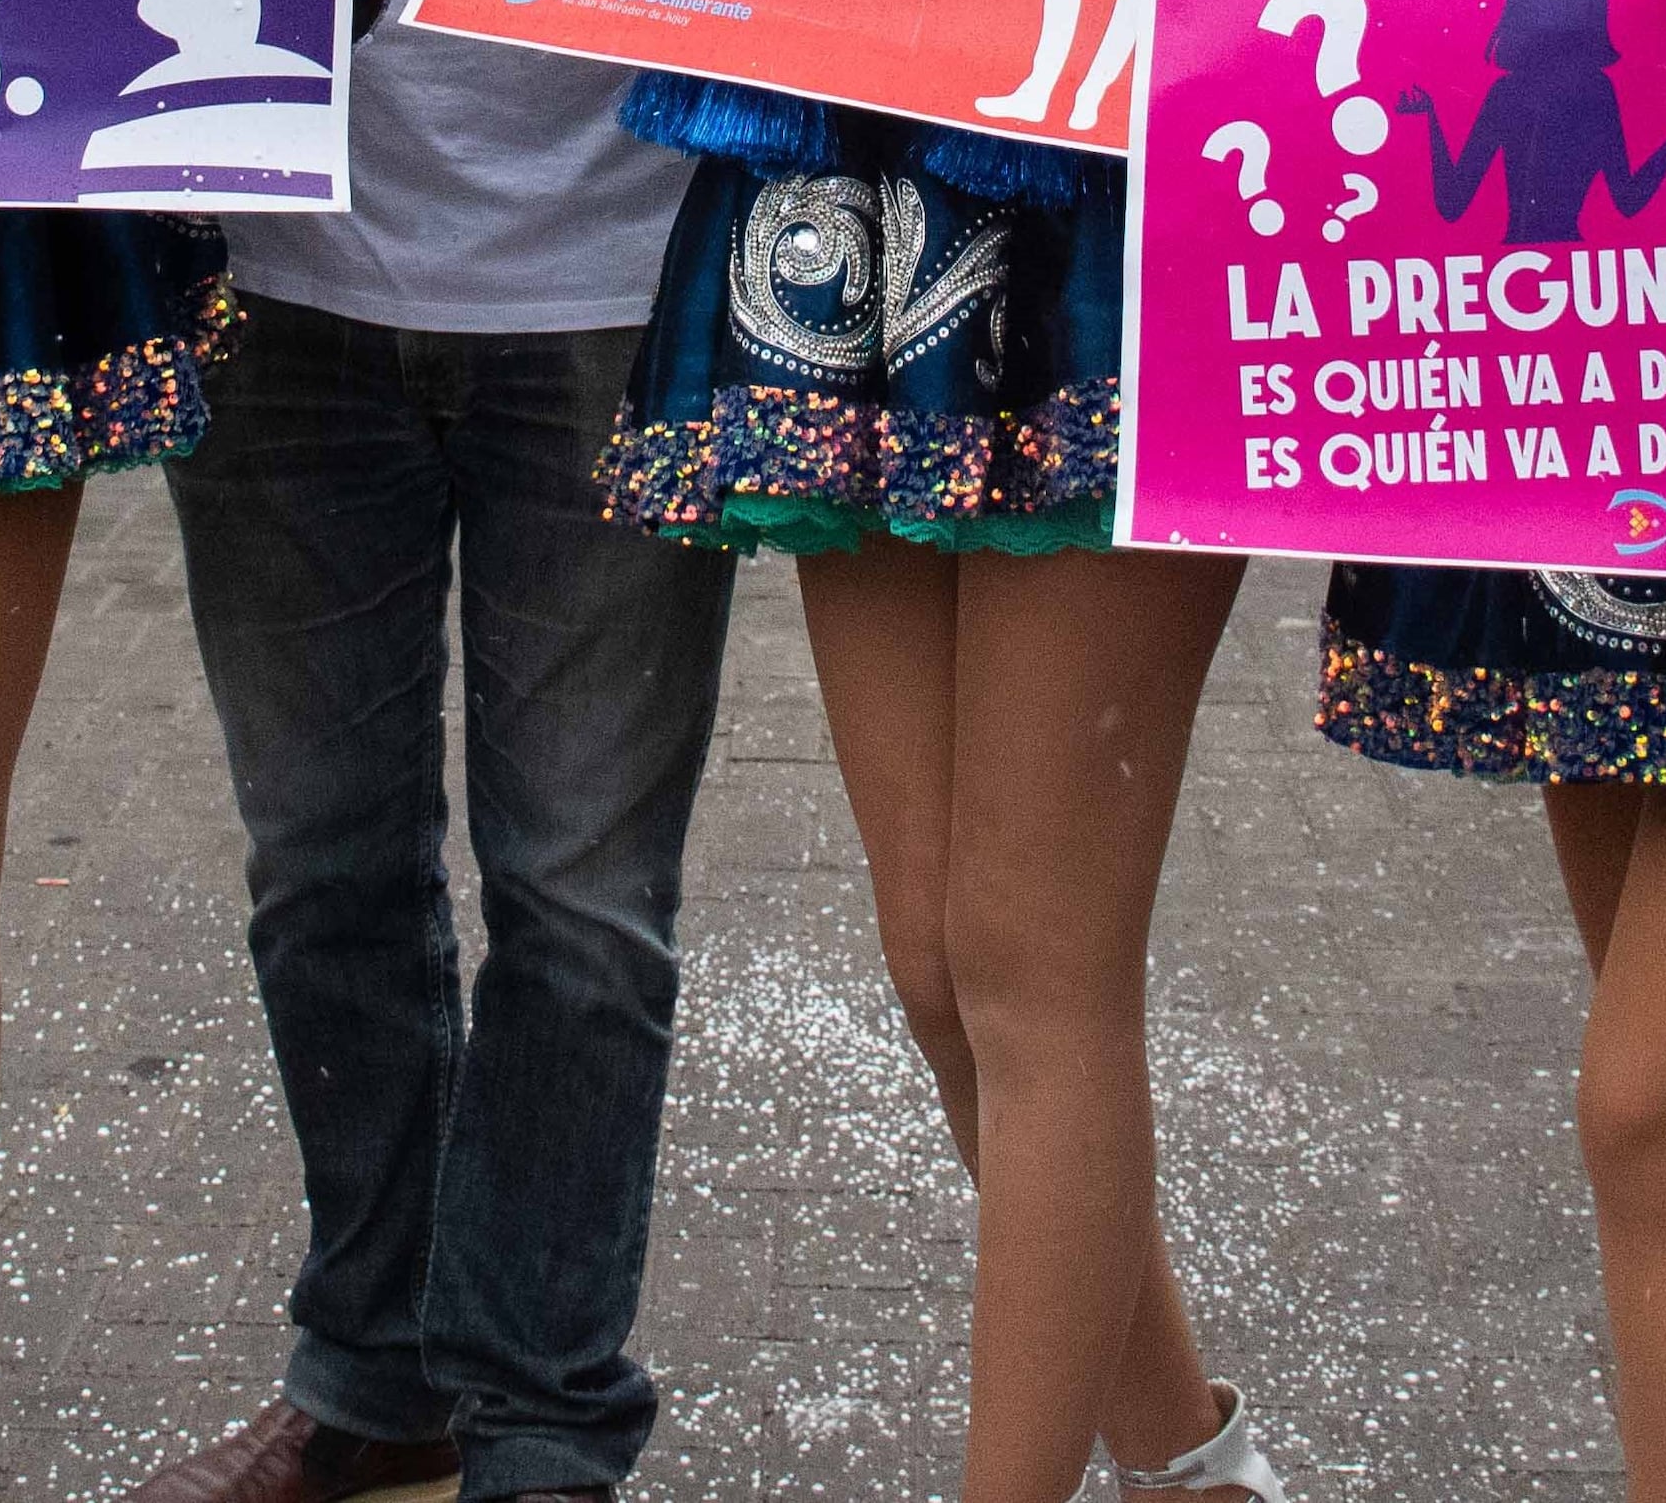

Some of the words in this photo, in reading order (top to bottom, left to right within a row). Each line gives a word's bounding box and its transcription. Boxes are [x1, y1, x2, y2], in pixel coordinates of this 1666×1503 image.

[599, 0, 646, 15] Salvador
[648, 9, 661, 19] de
[662, 12, 691, 26] Jujuy
[1228, 263, 1321, 340] LA
[1240, 364, 1295, 415] ES
[1314, 341, 1481, 417] QUIÉN
[1499, 355, 1563, 405] VA
[1581, 352, 1614, 402] A
[1246, 437, 1301, 488] ES
[1320, 413, 1487, 491] QUIÉN
[1505, 428, 1569, 478] VA
[1587, 426, 1620, 475] A
